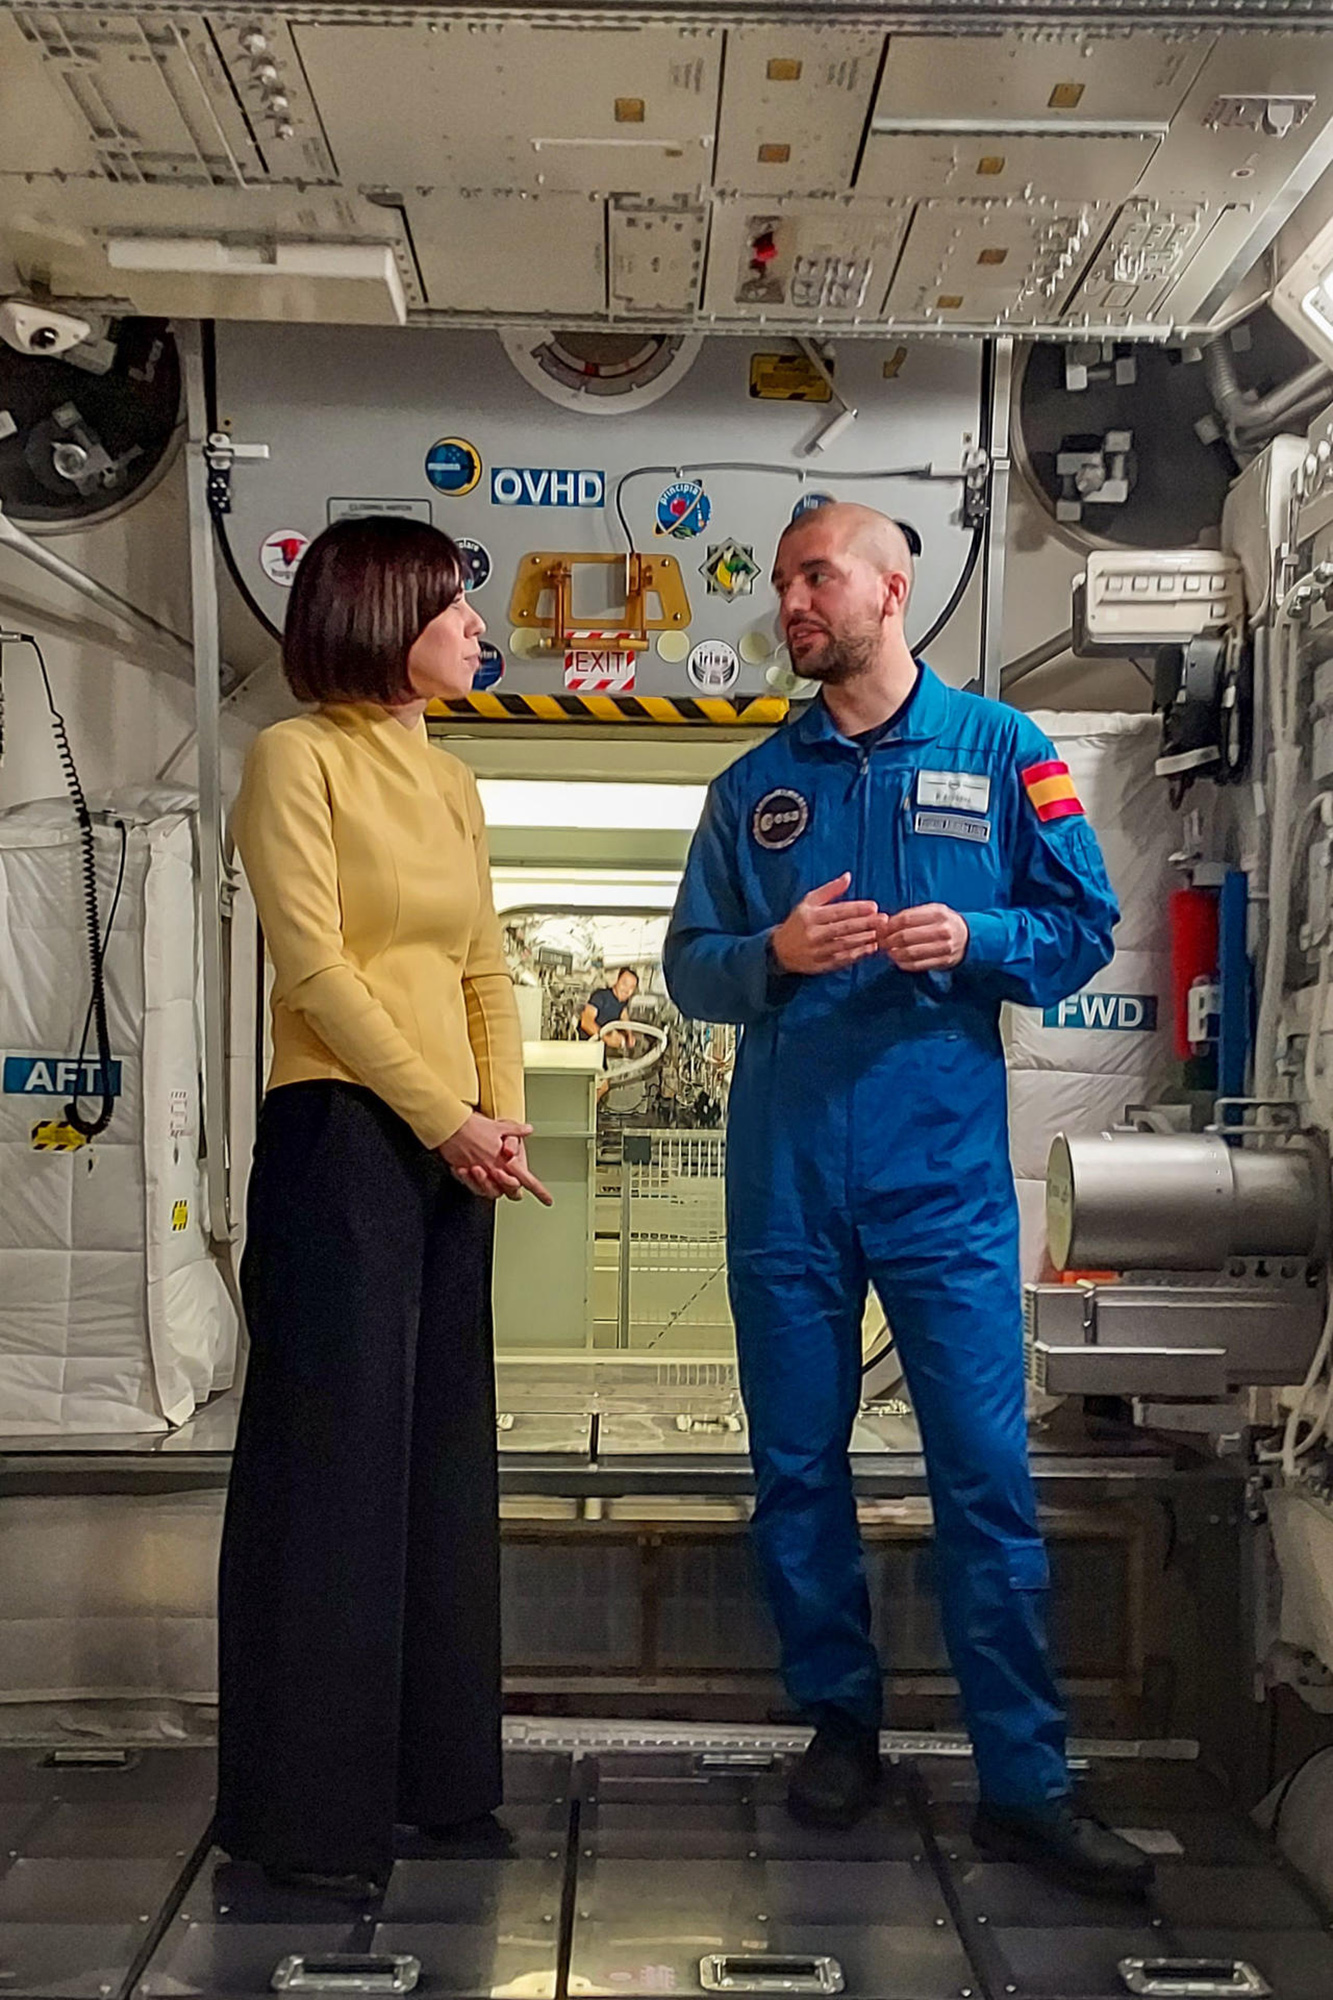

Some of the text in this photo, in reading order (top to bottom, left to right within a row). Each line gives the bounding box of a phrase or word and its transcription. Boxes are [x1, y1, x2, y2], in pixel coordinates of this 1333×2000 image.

[494, 468, 602, 505] OVHD
[660, 484, 699, 506] principia
[576, 651, 625, 673] EXIT
[1058, 993, 1143, 1028] FWD
[24, 1061, 101, 1092] AFT
